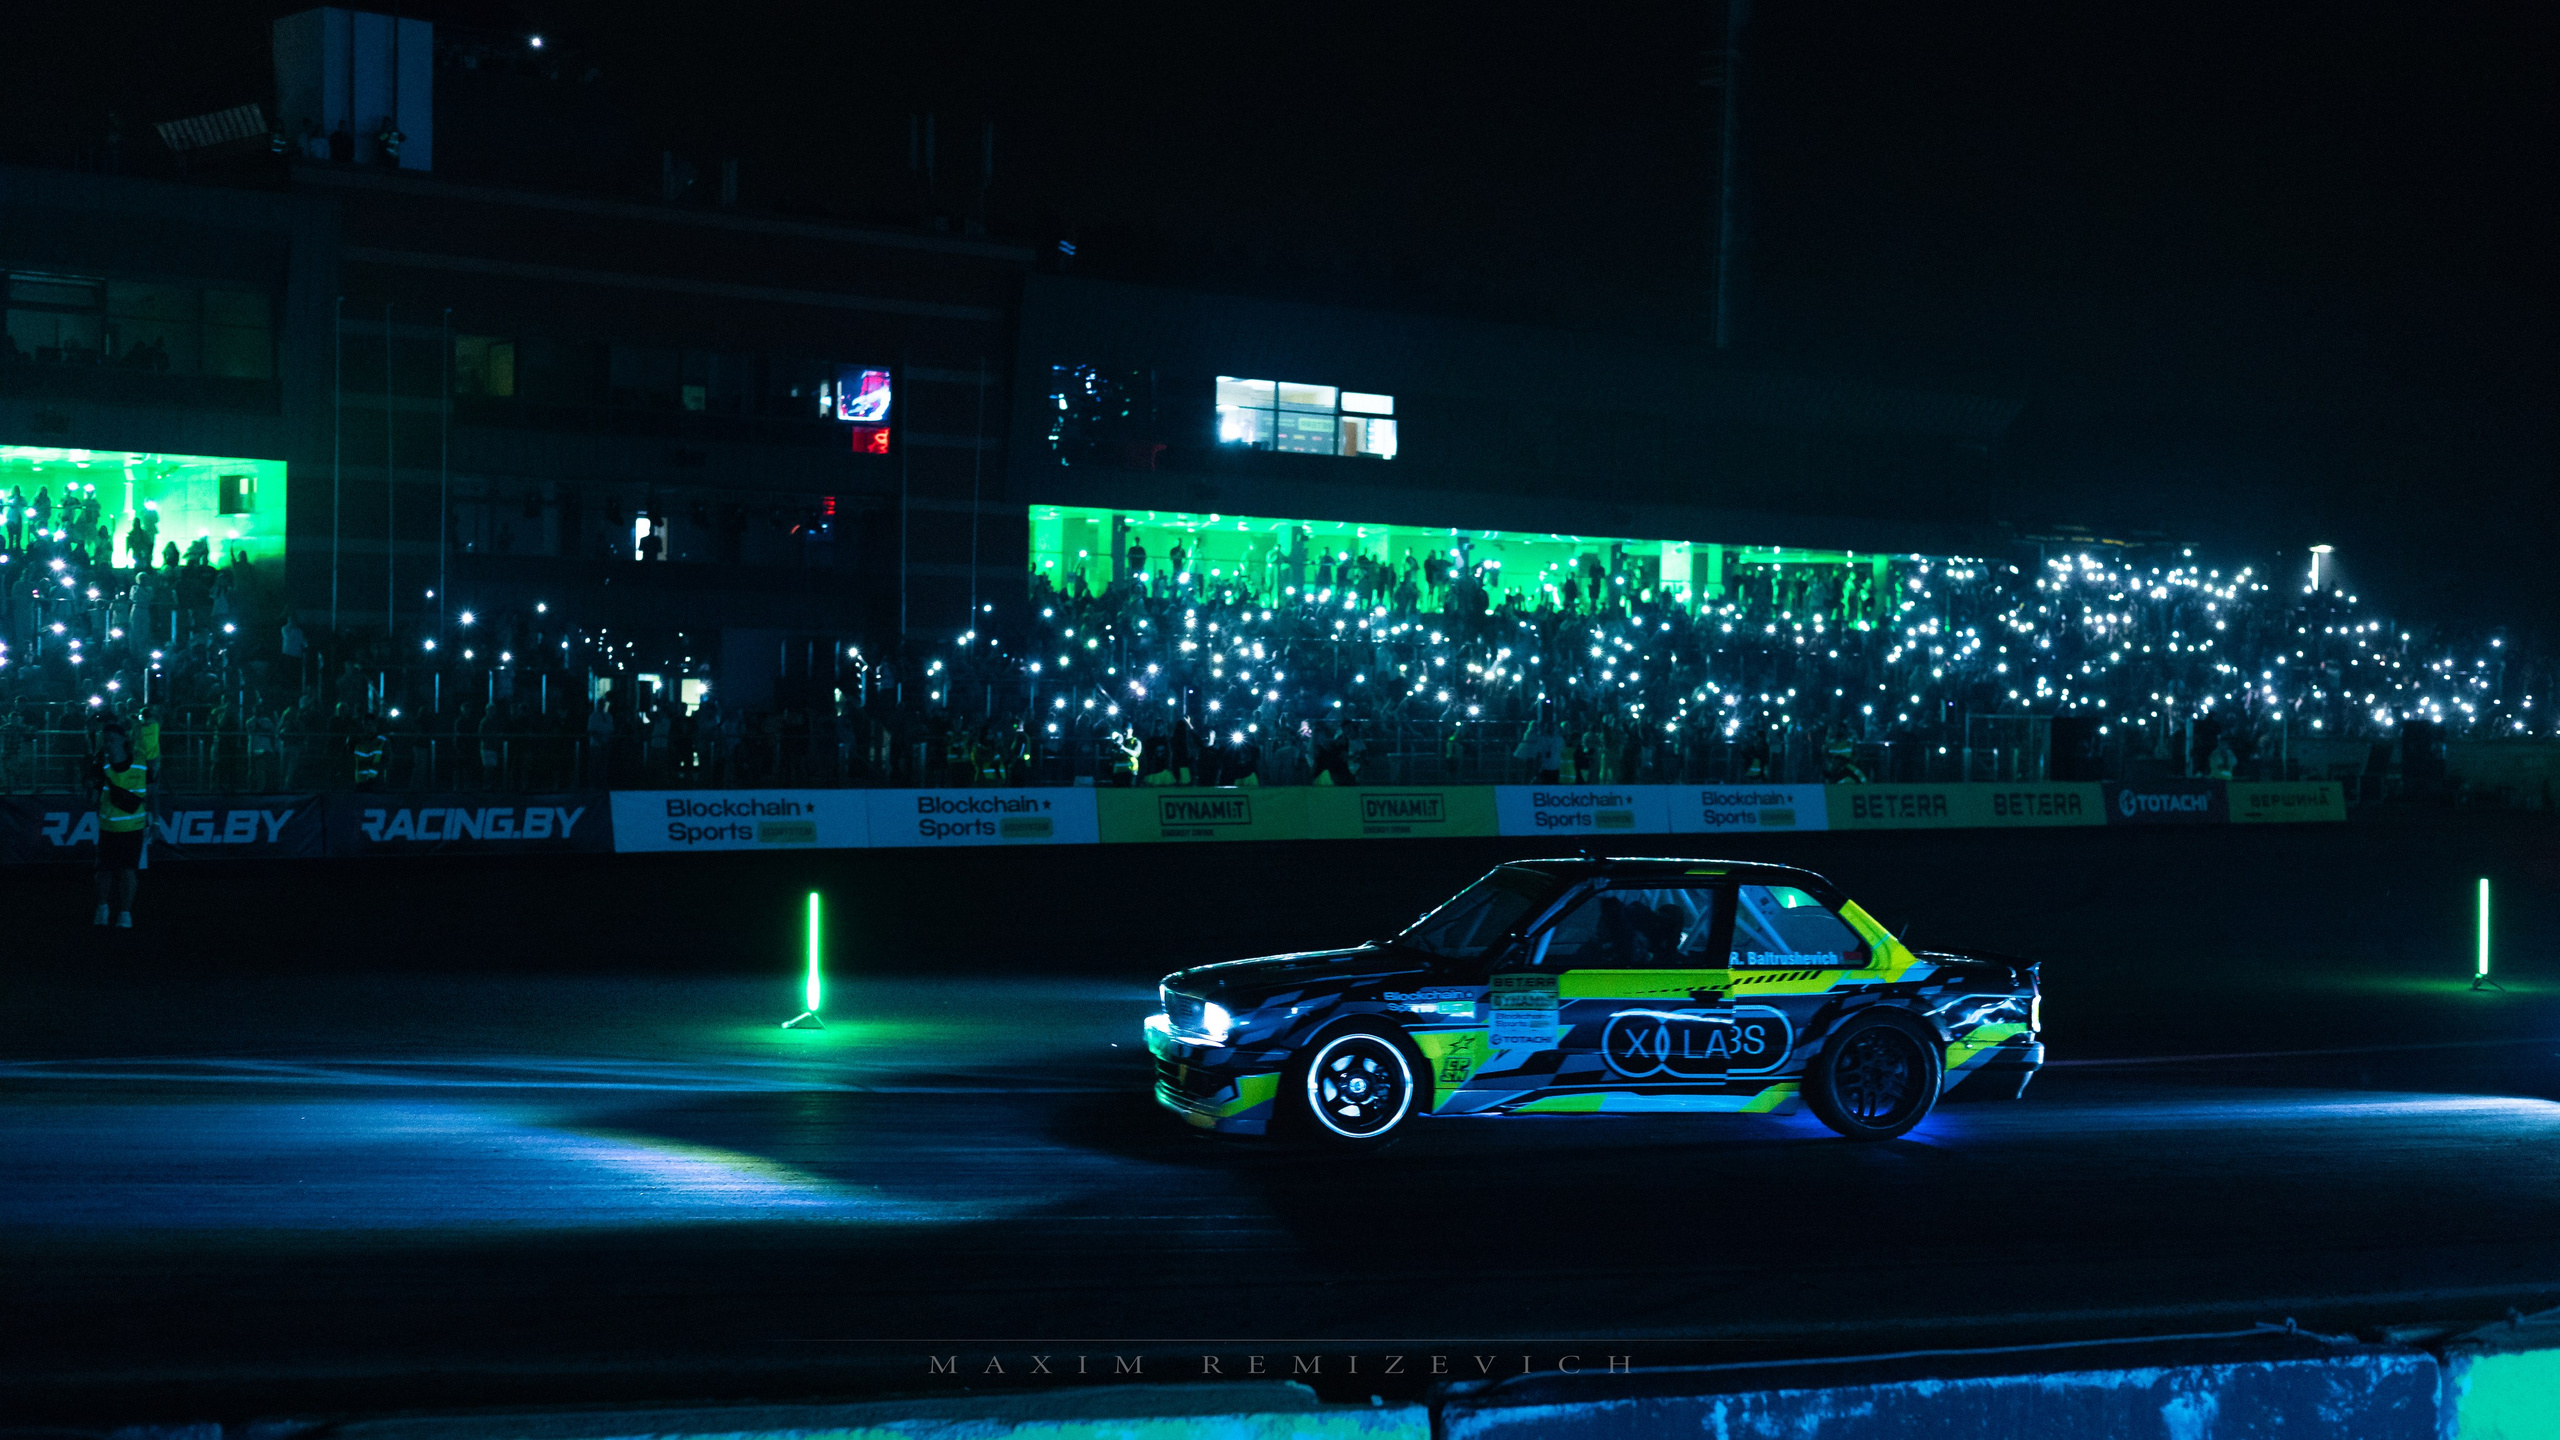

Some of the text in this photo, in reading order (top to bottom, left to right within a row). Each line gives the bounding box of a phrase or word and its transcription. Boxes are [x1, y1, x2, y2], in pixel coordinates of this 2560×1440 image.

[666, 797, 801, 818] Blockchain
[917, 795, 1039, 815] Blockchain
[1533, 792, 1623, 808] Blockchain
[1701, 791, 1785, 806] Blockchain
[1852, 794, 1948, 819] BETERA
[1993, 792, 2083, 816] BETERA
[2136, 793, 2208, 812] TOTACHI
[42, 808, 296, 847] RANG.BY
[361, 805, 585, 842] RACING.BY
[1534, 811, 1592, 830] Sports
[1703, 809, 1757, 827] Sports
[668, 822, 753, 845] Sports
[918, 818, 996, 840] Sports
